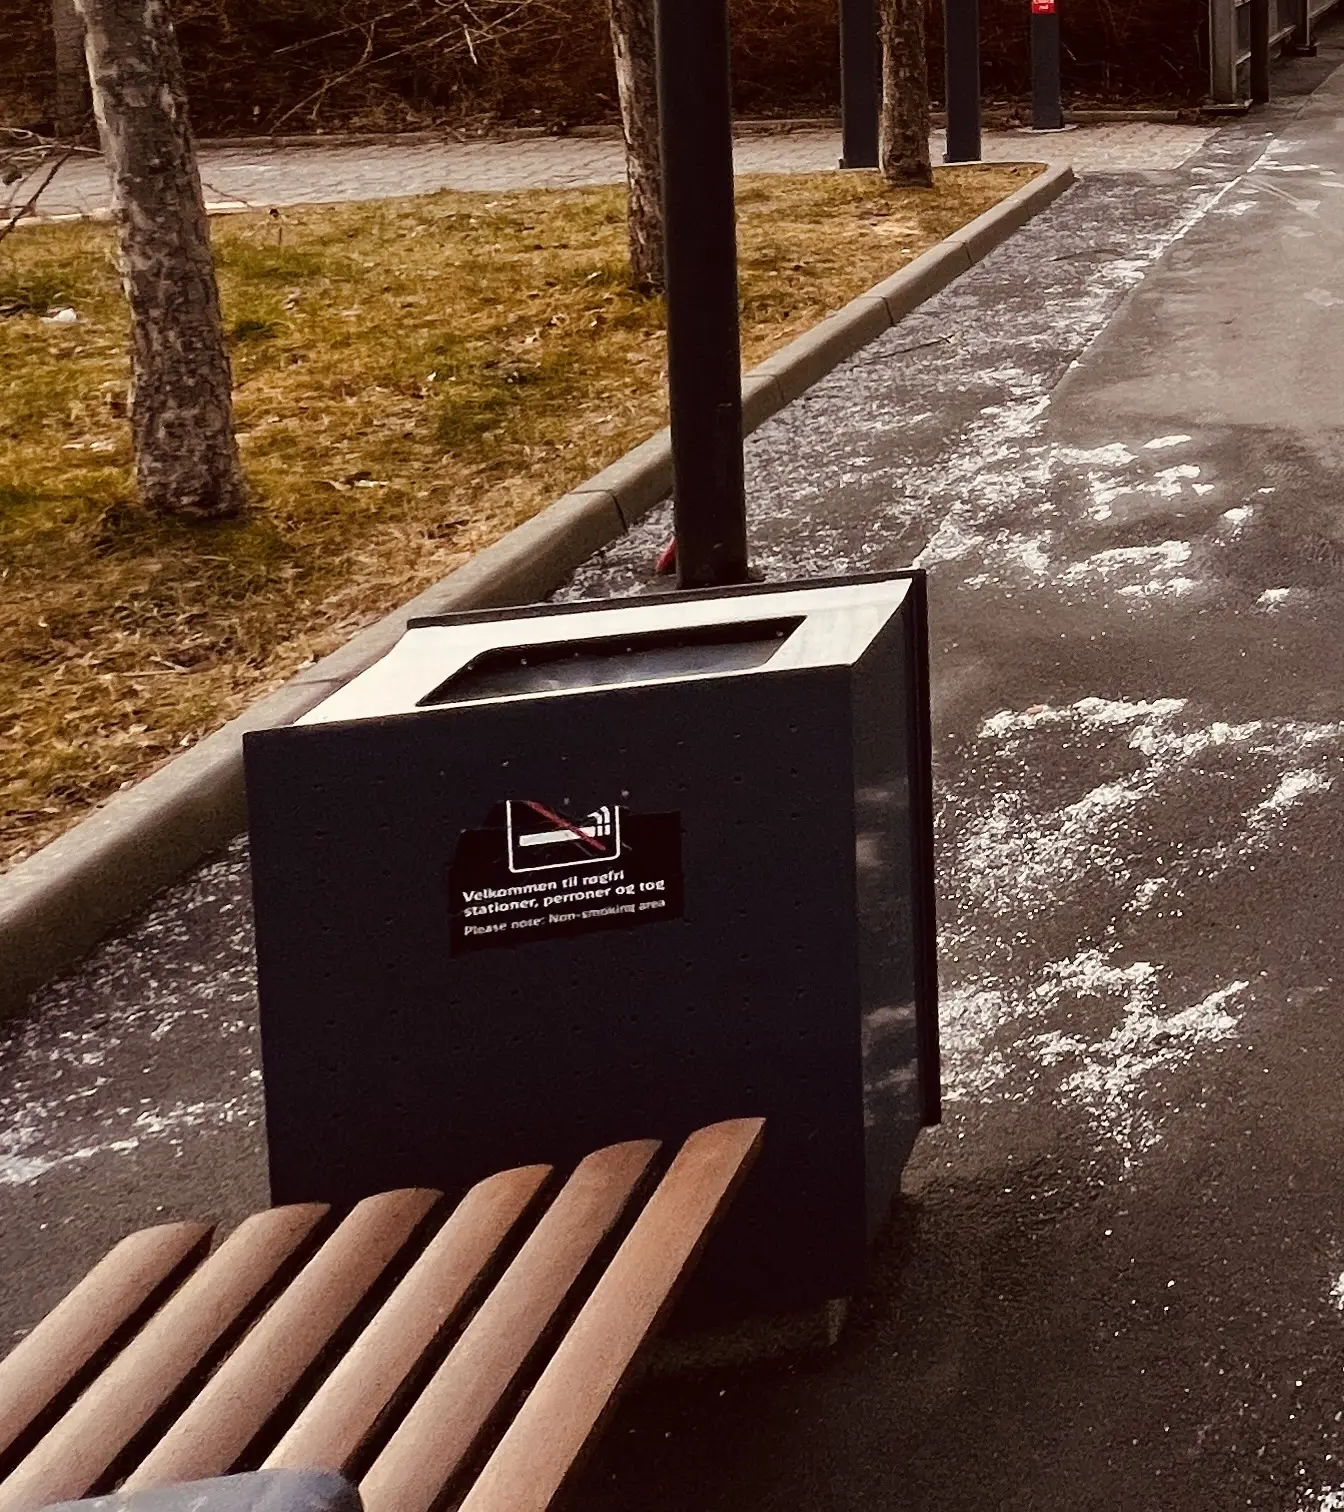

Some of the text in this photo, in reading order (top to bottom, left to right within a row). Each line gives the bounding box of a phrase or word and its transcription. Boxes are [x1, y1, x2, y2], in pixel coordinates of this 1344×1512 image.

[462, 881, 557, 903] Velkommen
[562, 875, 578, 888] til
[463, 879, 666, 918] stationer, perroner og tog
[464, 922, 507, 936] Please
